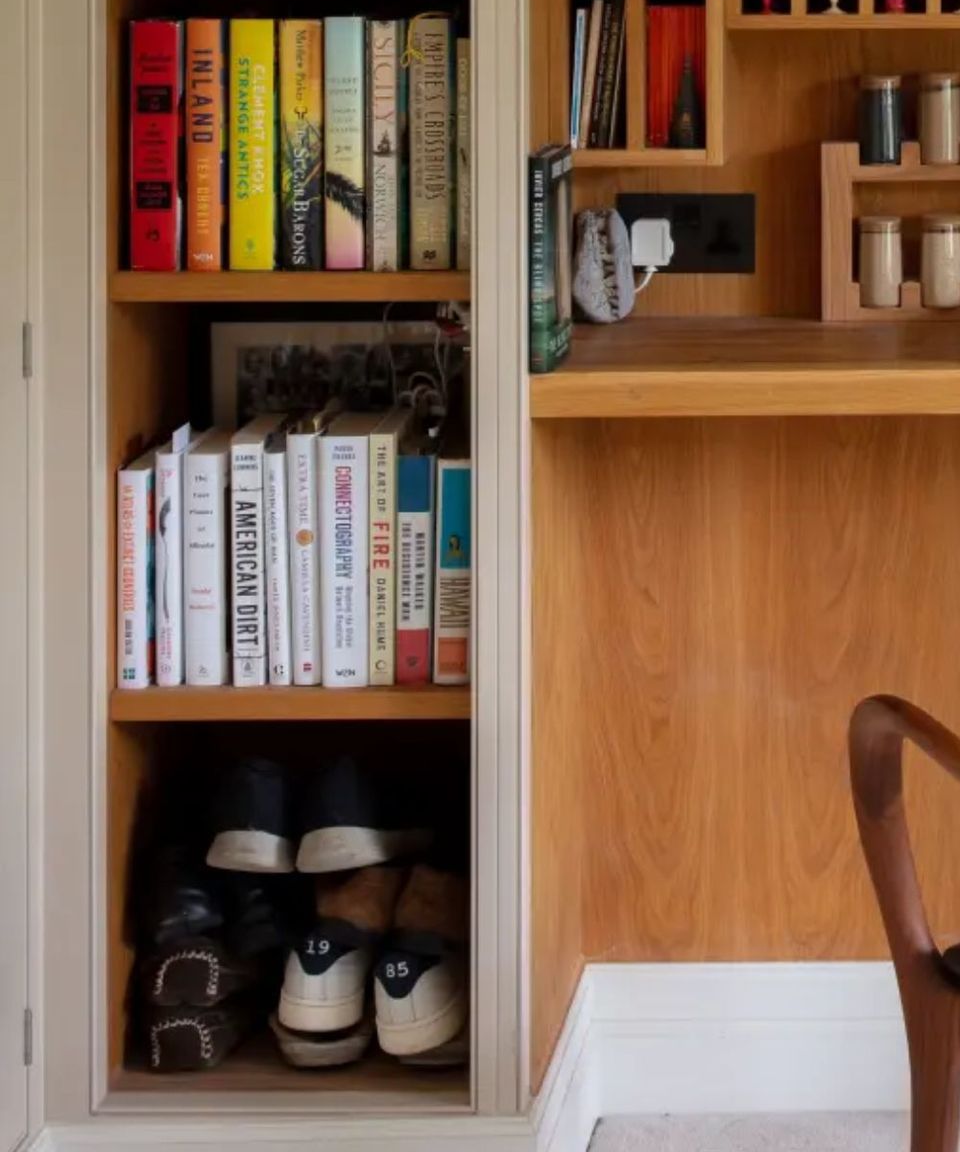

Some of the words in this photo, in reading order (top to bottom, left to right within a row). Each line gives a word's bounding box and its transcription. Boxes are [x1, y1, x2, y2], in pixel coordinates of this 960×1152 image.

[375, 37, 393, 125] SICILY
[424, 33, 445, 102] EMPIRE'S
[192, 49, 213, 144] INLAND
[238, 58, 249, 134] STRANGE
[252, 65, 265, 140] CLEMENT
[238, 140, 249, 200] ANTICS
[252, 147, 265, 193] KNOX
[424, 111, 445, 200] CROSSROADS
[292, 200, 309, 264] BARONS
[297, 454, 308, 493] EXTRA
[377, 446, 386, 466] THE
[377, 472, 386, 494] ART
[377, 498, 386, 512] OF
[298, 496, 308, 526] TIME
[335, 466, 352, 579] CONNECTOGRAPHY
[235, 500, 258, 596] AMERICAN
[373, 522, 390, 569] FIRE
[377, 578, 386, 616] DANIEL
[440, 577, 470, 629] HAWAII
[235, 604, 258, 646] DIRT
[377, 622, 386, 651] HUME
[306, 940, 331, 955] 19
[385, 961, 409, 978] 85
